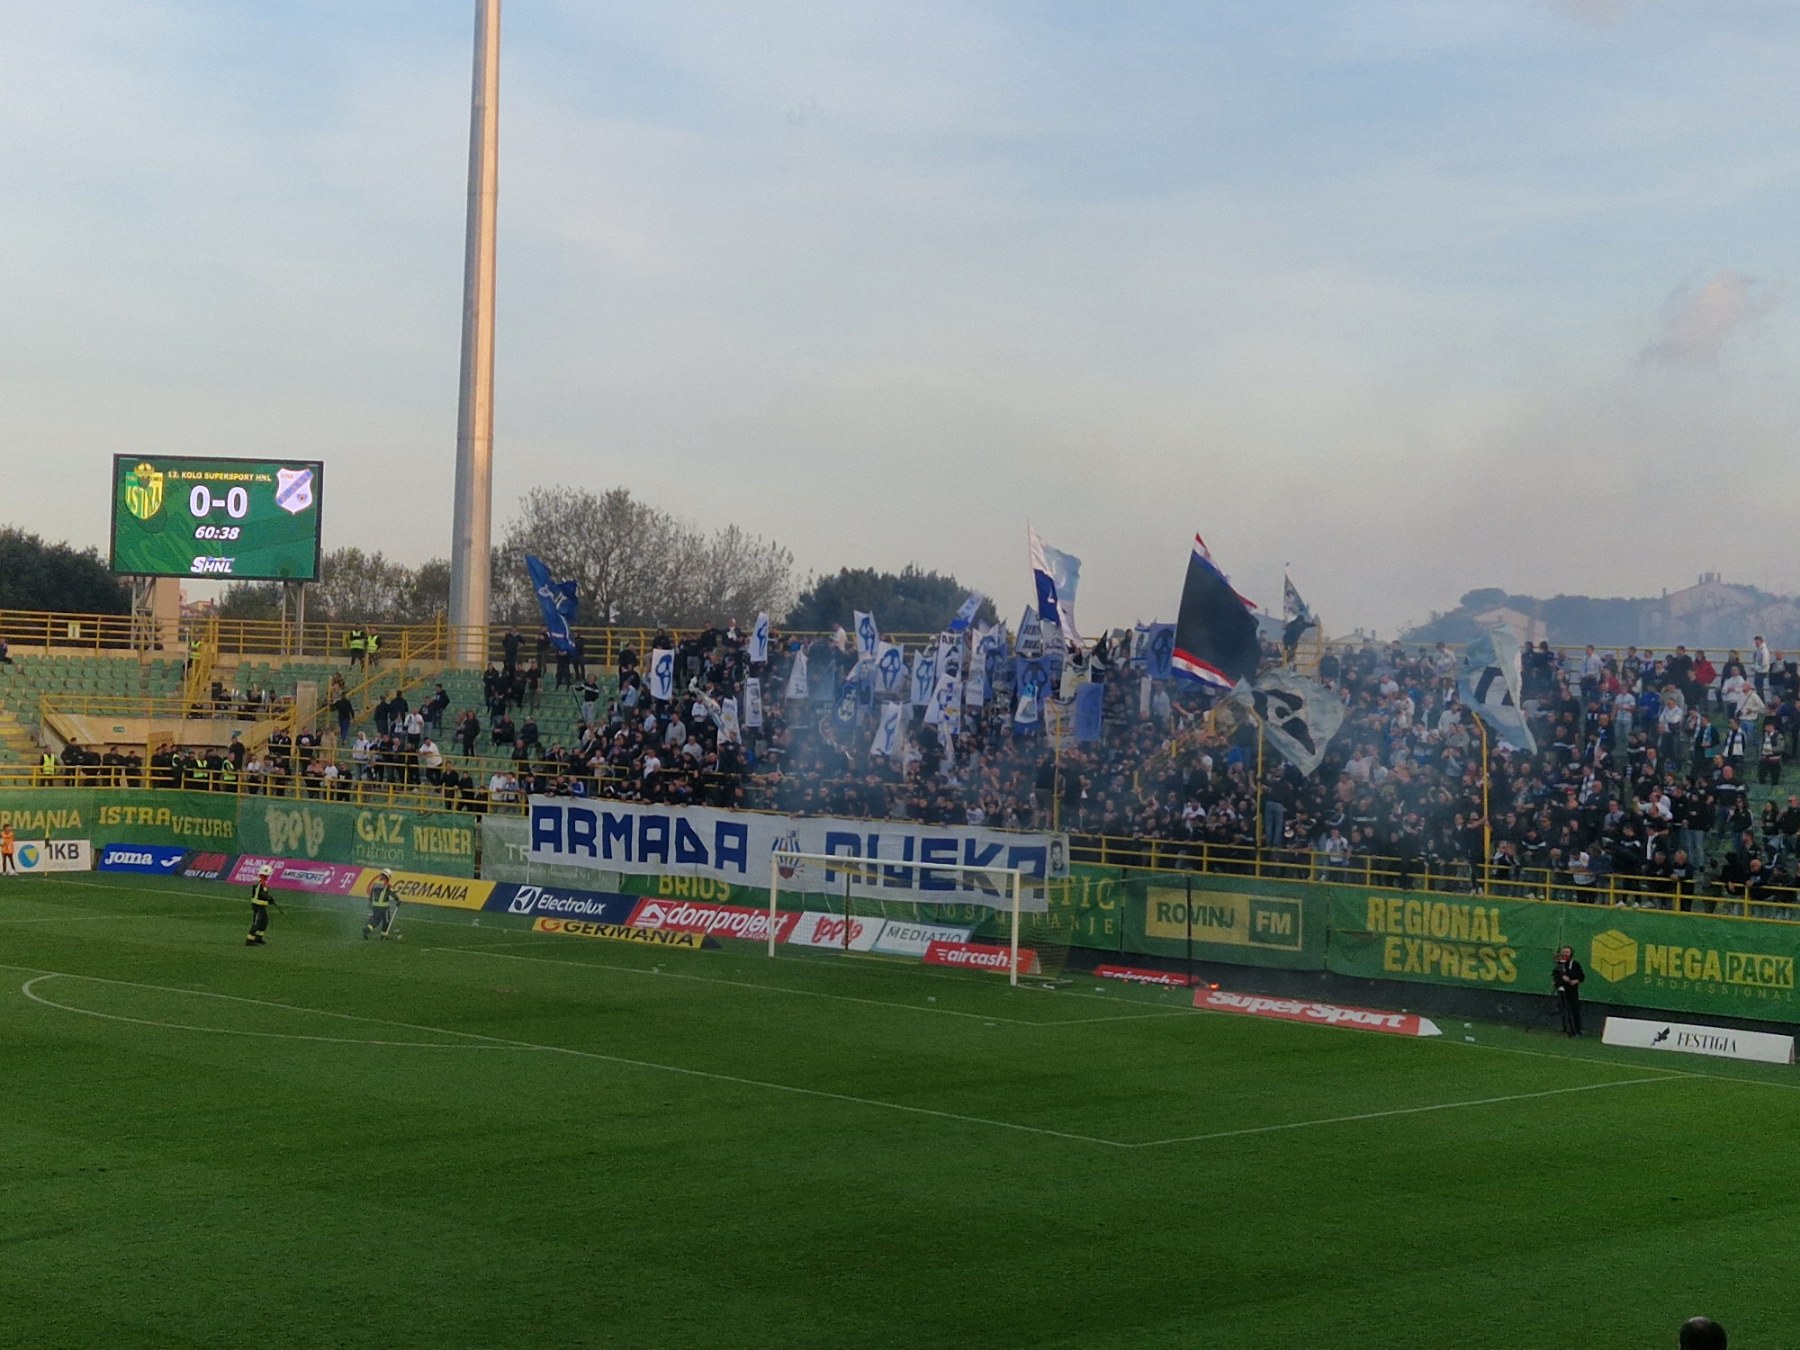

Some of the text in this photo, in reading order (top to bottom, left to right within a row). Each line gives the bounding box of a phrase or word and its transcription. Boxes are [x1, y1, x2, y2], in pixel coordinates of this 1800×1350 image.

[181, 471, 202, 480] KOLO
[204, 472, 254, 481] SUPERSPORT
[256, 473, 272, 482] HNL
[189, 485, 248, 518] 0-0
[195, 525, 240, 540] 60:38
[98, 806, 171, 826] ISTRA
[171, 815, 233, 838] VETURA
[357, 810, 405, 844] GAZ
[356, 842, 404, 861] nutrition
[531, 804, 749, 874] ARMADA
[825, 831, 1047, 899] RIJEKA
[392, 879, 469, 902] GERMANIA
[536, 893, 607, 916] Electrolux
[1156, 901, 1236, 930] ROVINJ
[1255, 909, 1292, 936] FM
[1366, 896, 1508, 944] REGIONAL
[563, 919, 694, 949] GERMANIA
[947, 947, 1008, 969] aircash
[1383, 936, 1518, 983] EXPRESS
[1644, 943, 1722, 983] MEGA
[1728, 956, 1791, 986] PACK
[1644, 977, 1793, 1002] PROFESSIONAL
[1206, 990, 1407, 1028] SuperSport
[1676, 1031, 1737, 1054] FESTIGIA
